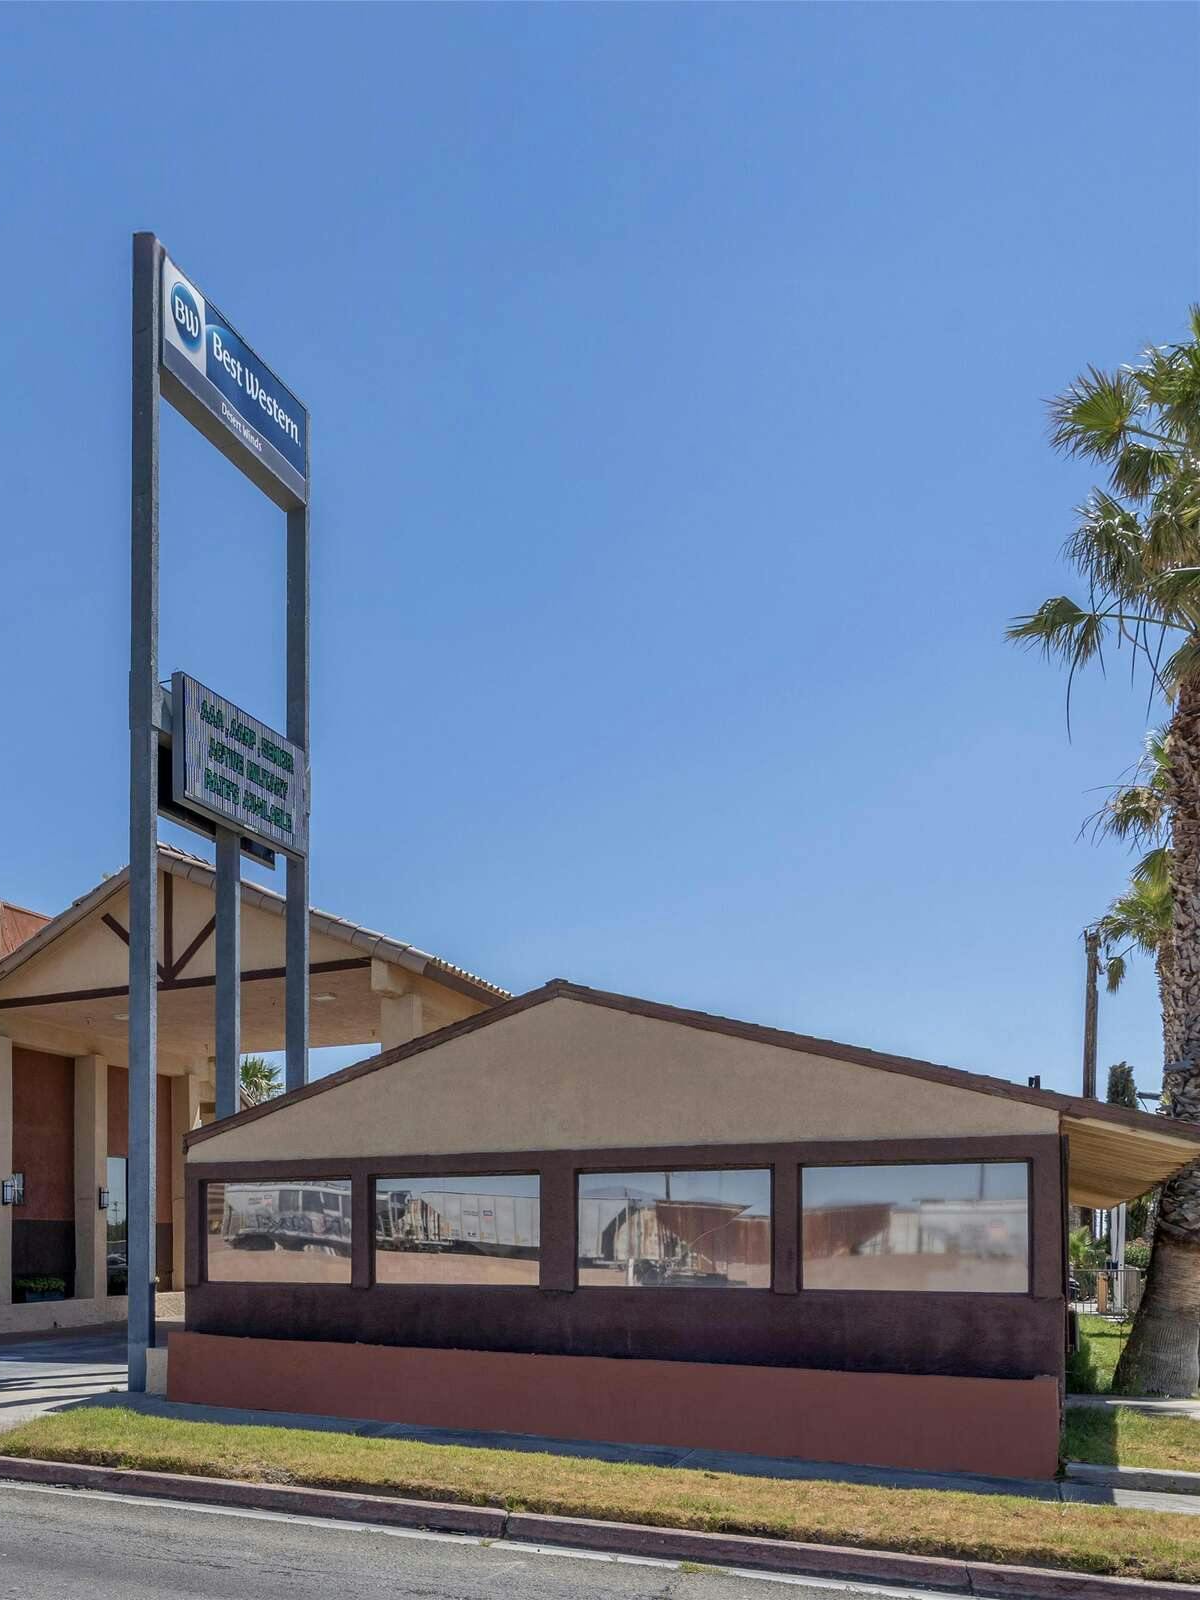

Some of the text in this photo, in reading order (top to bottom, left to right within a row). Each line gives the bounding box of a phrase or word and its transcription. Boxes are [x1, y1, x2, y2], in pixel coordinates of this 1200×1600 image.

[174, 296, 199, 338] BW
[212, 331, 243, 387] Best
[221, 401, 263, 451] Desert Winds
